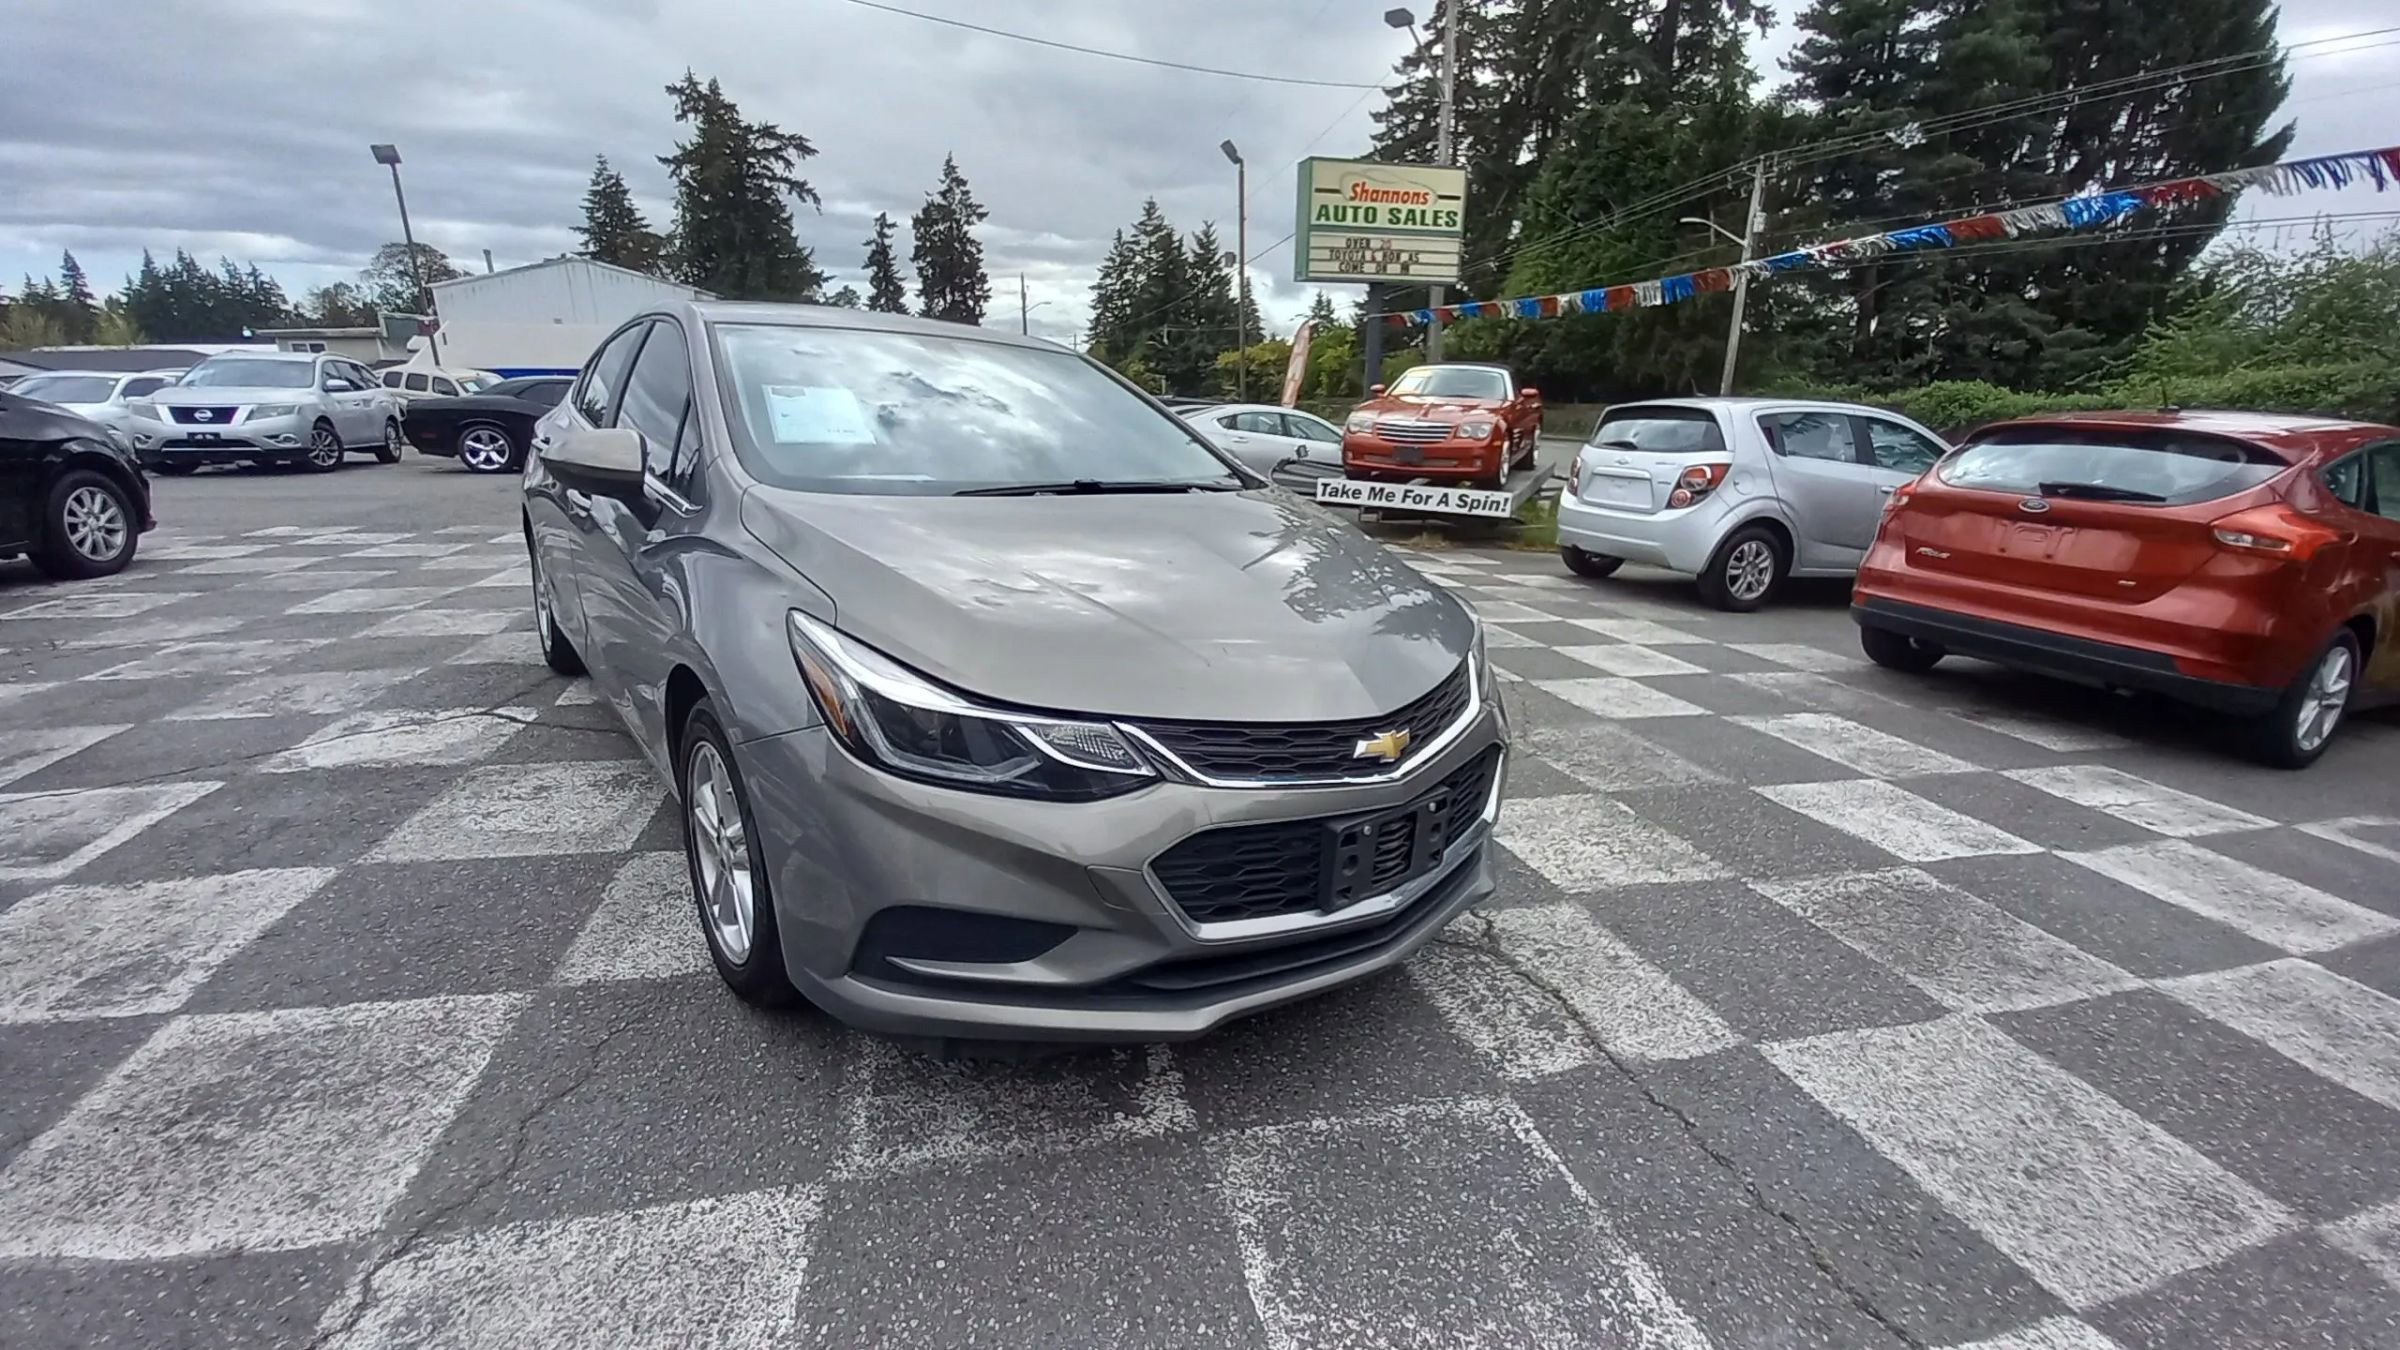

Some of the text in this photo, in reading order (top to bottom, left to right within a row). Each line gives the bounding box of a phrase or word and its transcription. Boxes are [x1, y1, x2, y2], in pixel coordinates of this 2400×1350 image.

[1349, 181, 1430, 205] Shannons
[1315, 204, 1459, 228] AUTO SALES
[1346, 237, 1371, 249] OVER
[1329, 248, 1366, 262] TOYOTA
[1338, 261, 1365, 274] COME
[1320, 482, 1511, 513] Take Me For A Spin!
